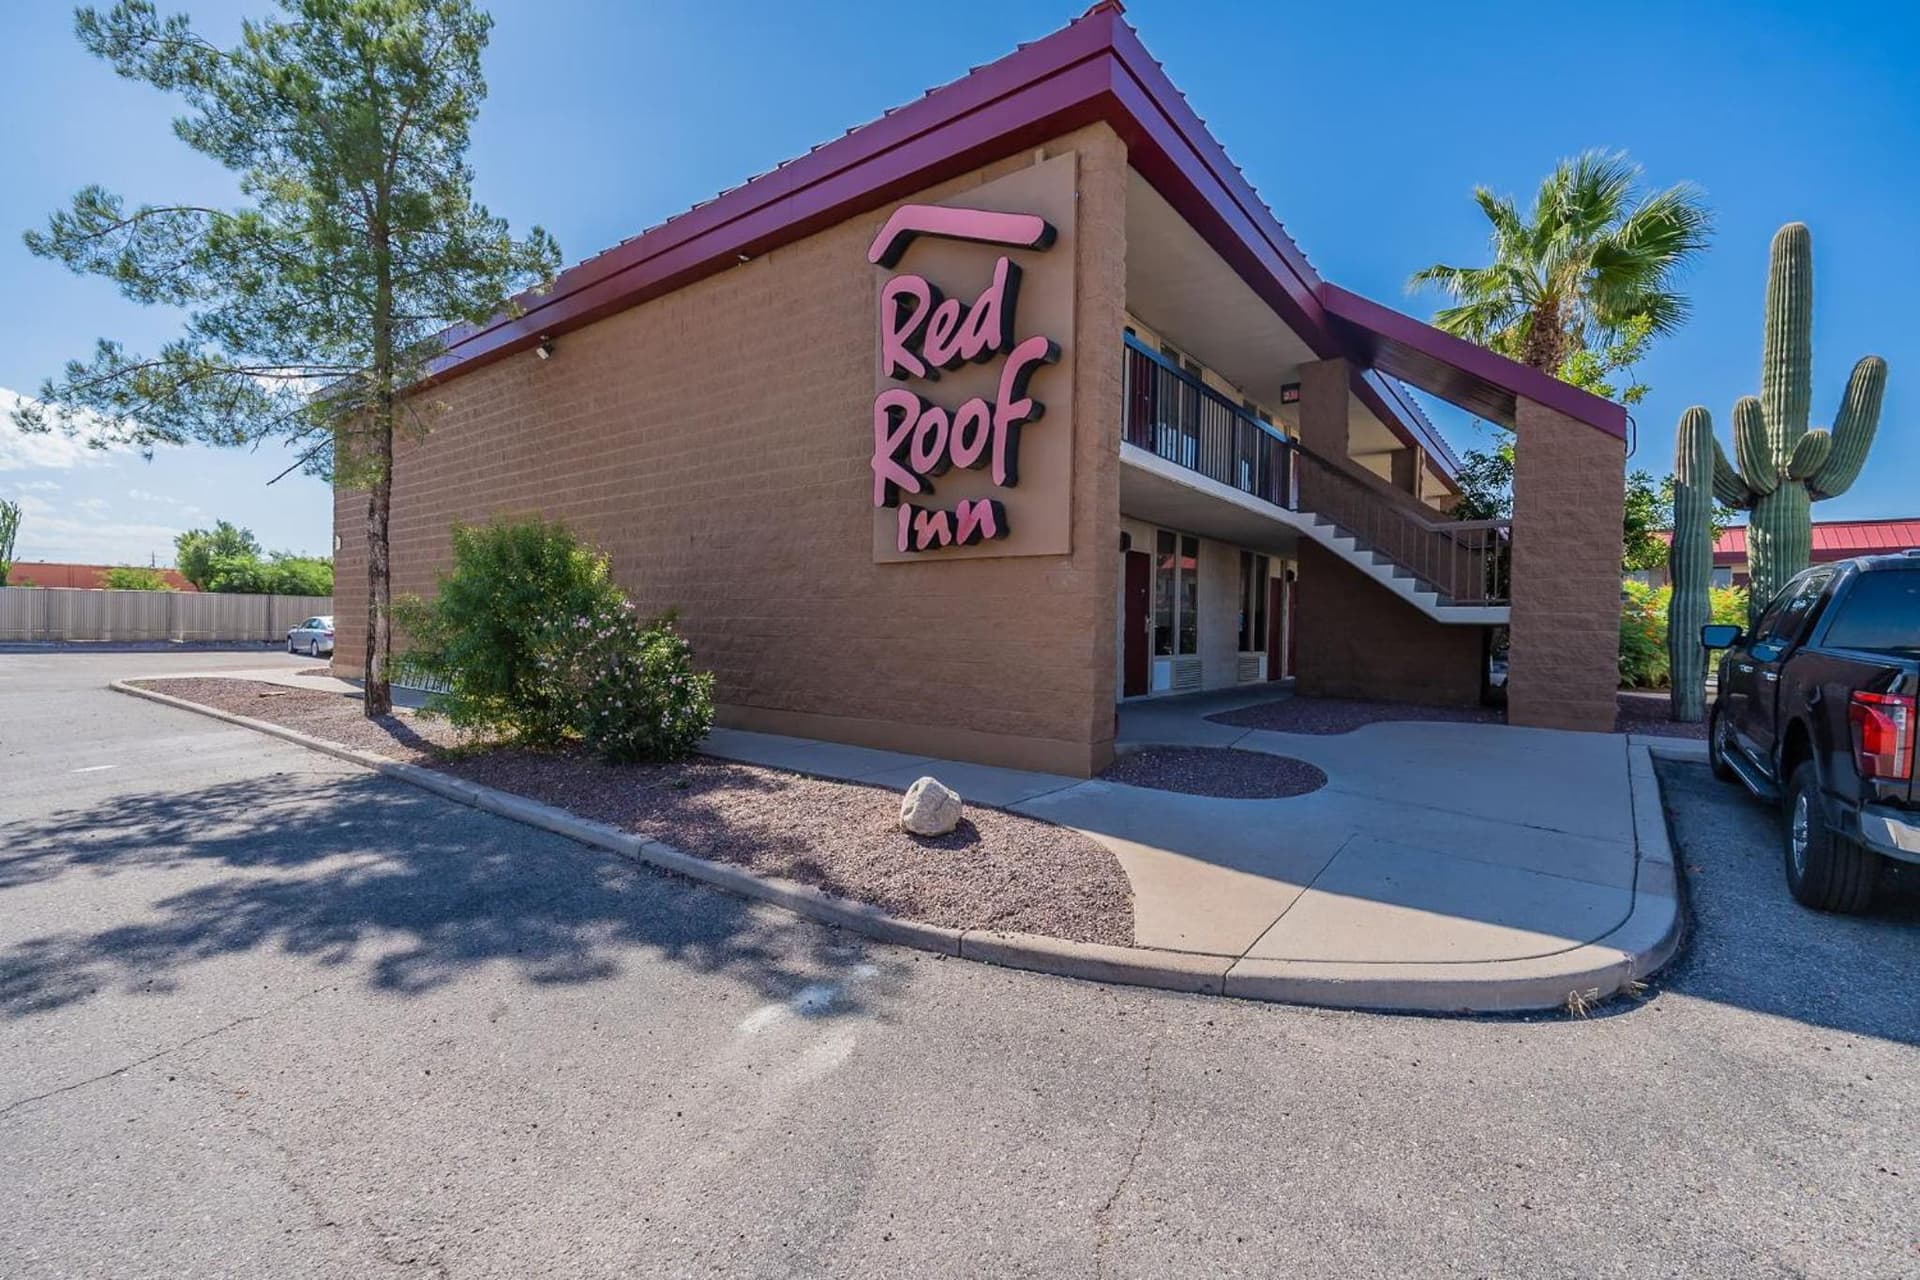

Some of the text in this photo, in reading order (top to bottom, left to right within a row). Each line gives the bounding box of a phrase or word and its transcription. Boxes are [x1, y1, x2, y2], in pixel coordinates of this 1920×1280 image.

[881, 255, 1010, 379] Red
[871, 335, 1050, 508] Roof
[897, 498, 998, 552] Inn
